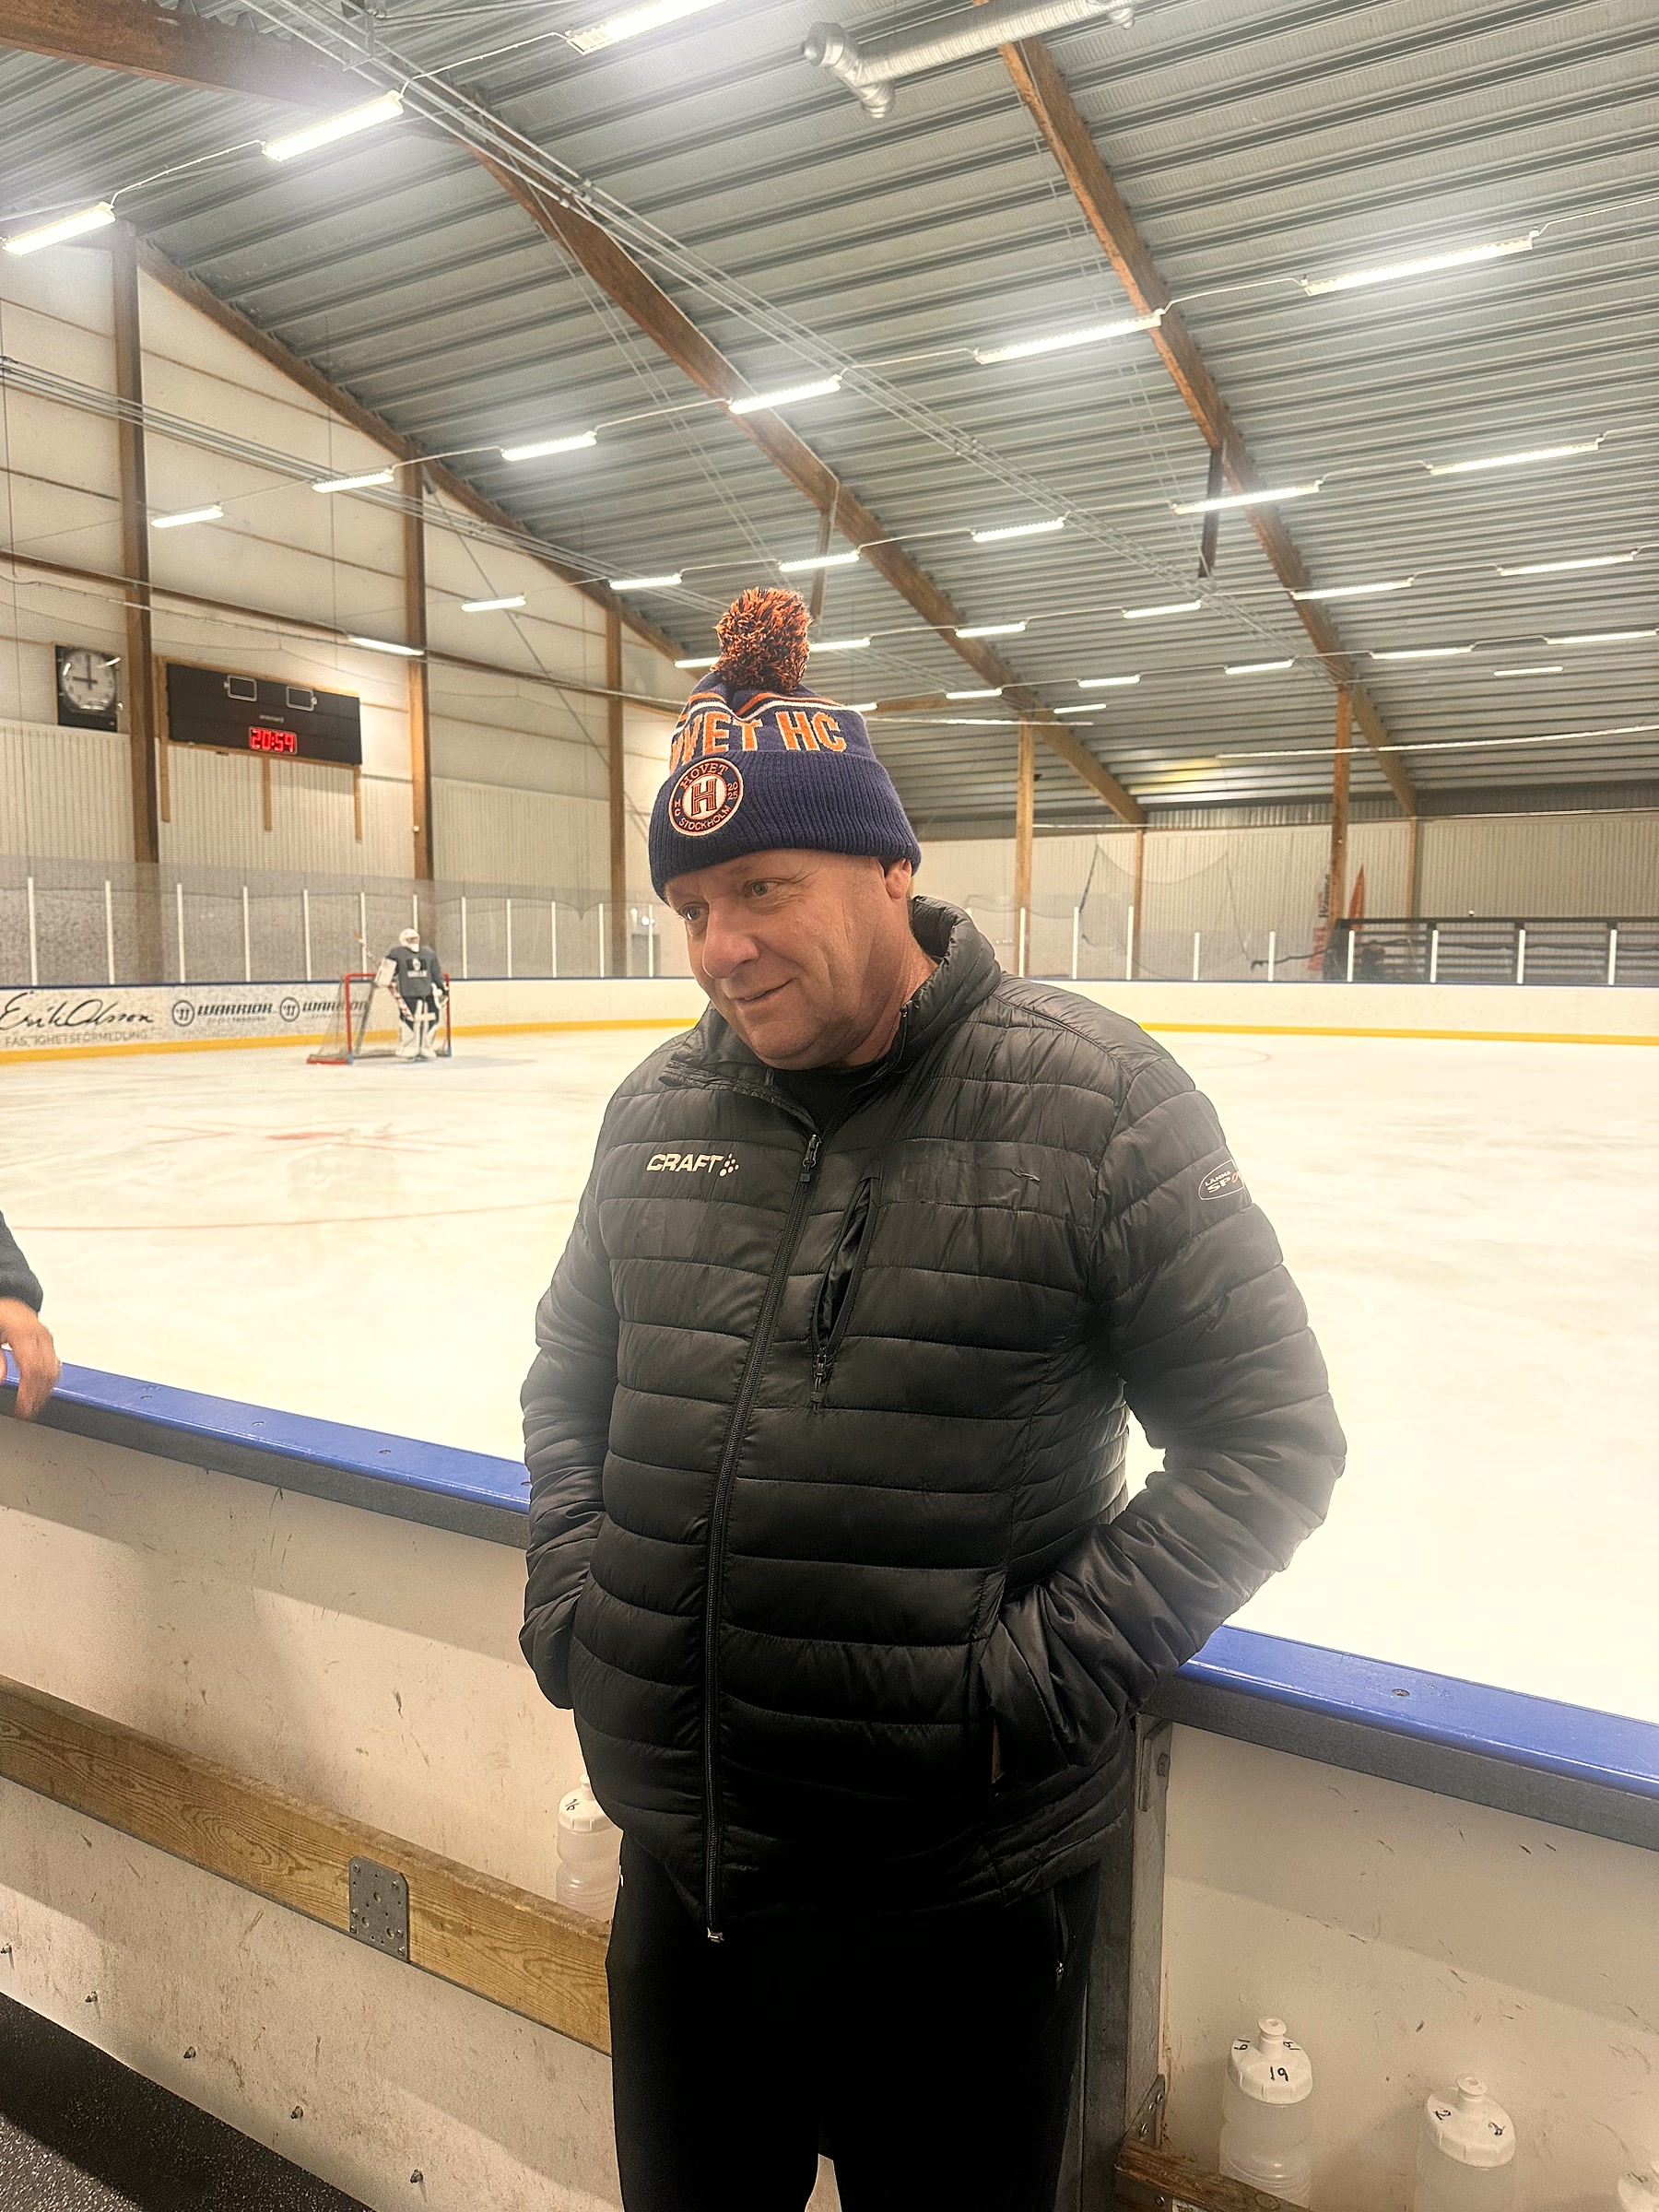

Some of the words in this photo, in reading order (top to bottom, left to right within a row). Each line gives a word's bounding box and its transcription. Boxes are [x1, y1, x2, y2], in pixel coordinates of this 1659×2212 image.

[250, 727, 295, 753] 20:59
[775, 710, 847, 753] HC
[679, 762, 729, 790] HOVET
[727, 781, 739, 792] 20
[690, 778, 718, 817] H
[727, 792, 739, 801] 25
[678, 805, 733, 830] STOCKHOLM
[0, 991, 68, 1030] Erik
[196, 1002, 274, 1016] WARRIOR
[646, 1153, 724, 1173] CRAFT
[1269, 2065, 1289, 2082] 19
